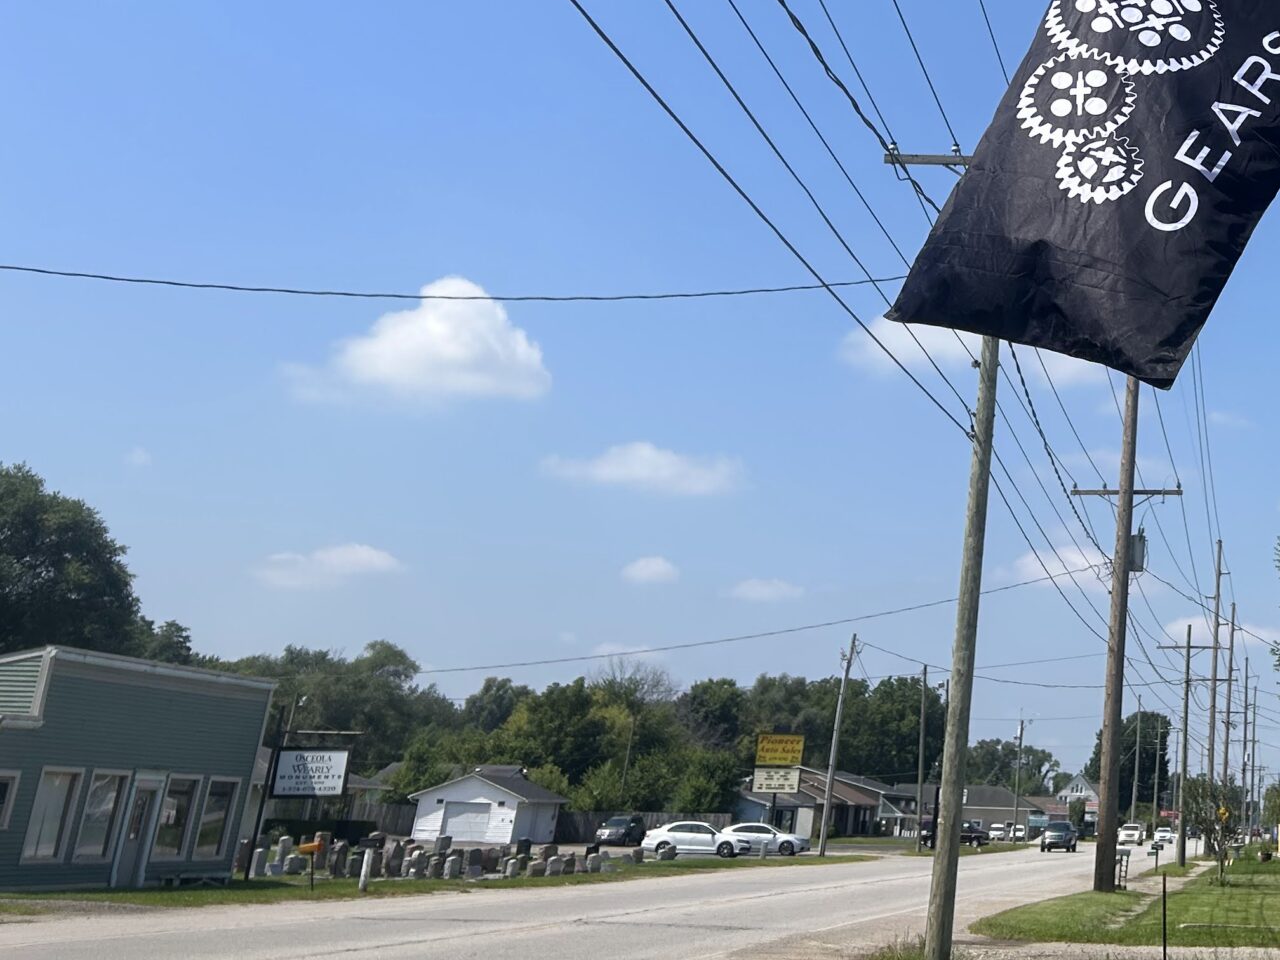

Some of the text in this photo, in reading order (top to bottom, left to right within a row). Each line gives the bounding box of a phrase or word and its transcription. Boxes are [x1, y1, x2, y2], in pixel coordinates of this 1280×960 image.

[760, 735, 802, 744] Pioneer
[295, 753, 332, 762] OSCEOLA
[292, 762, 333, 774] WEARLY
